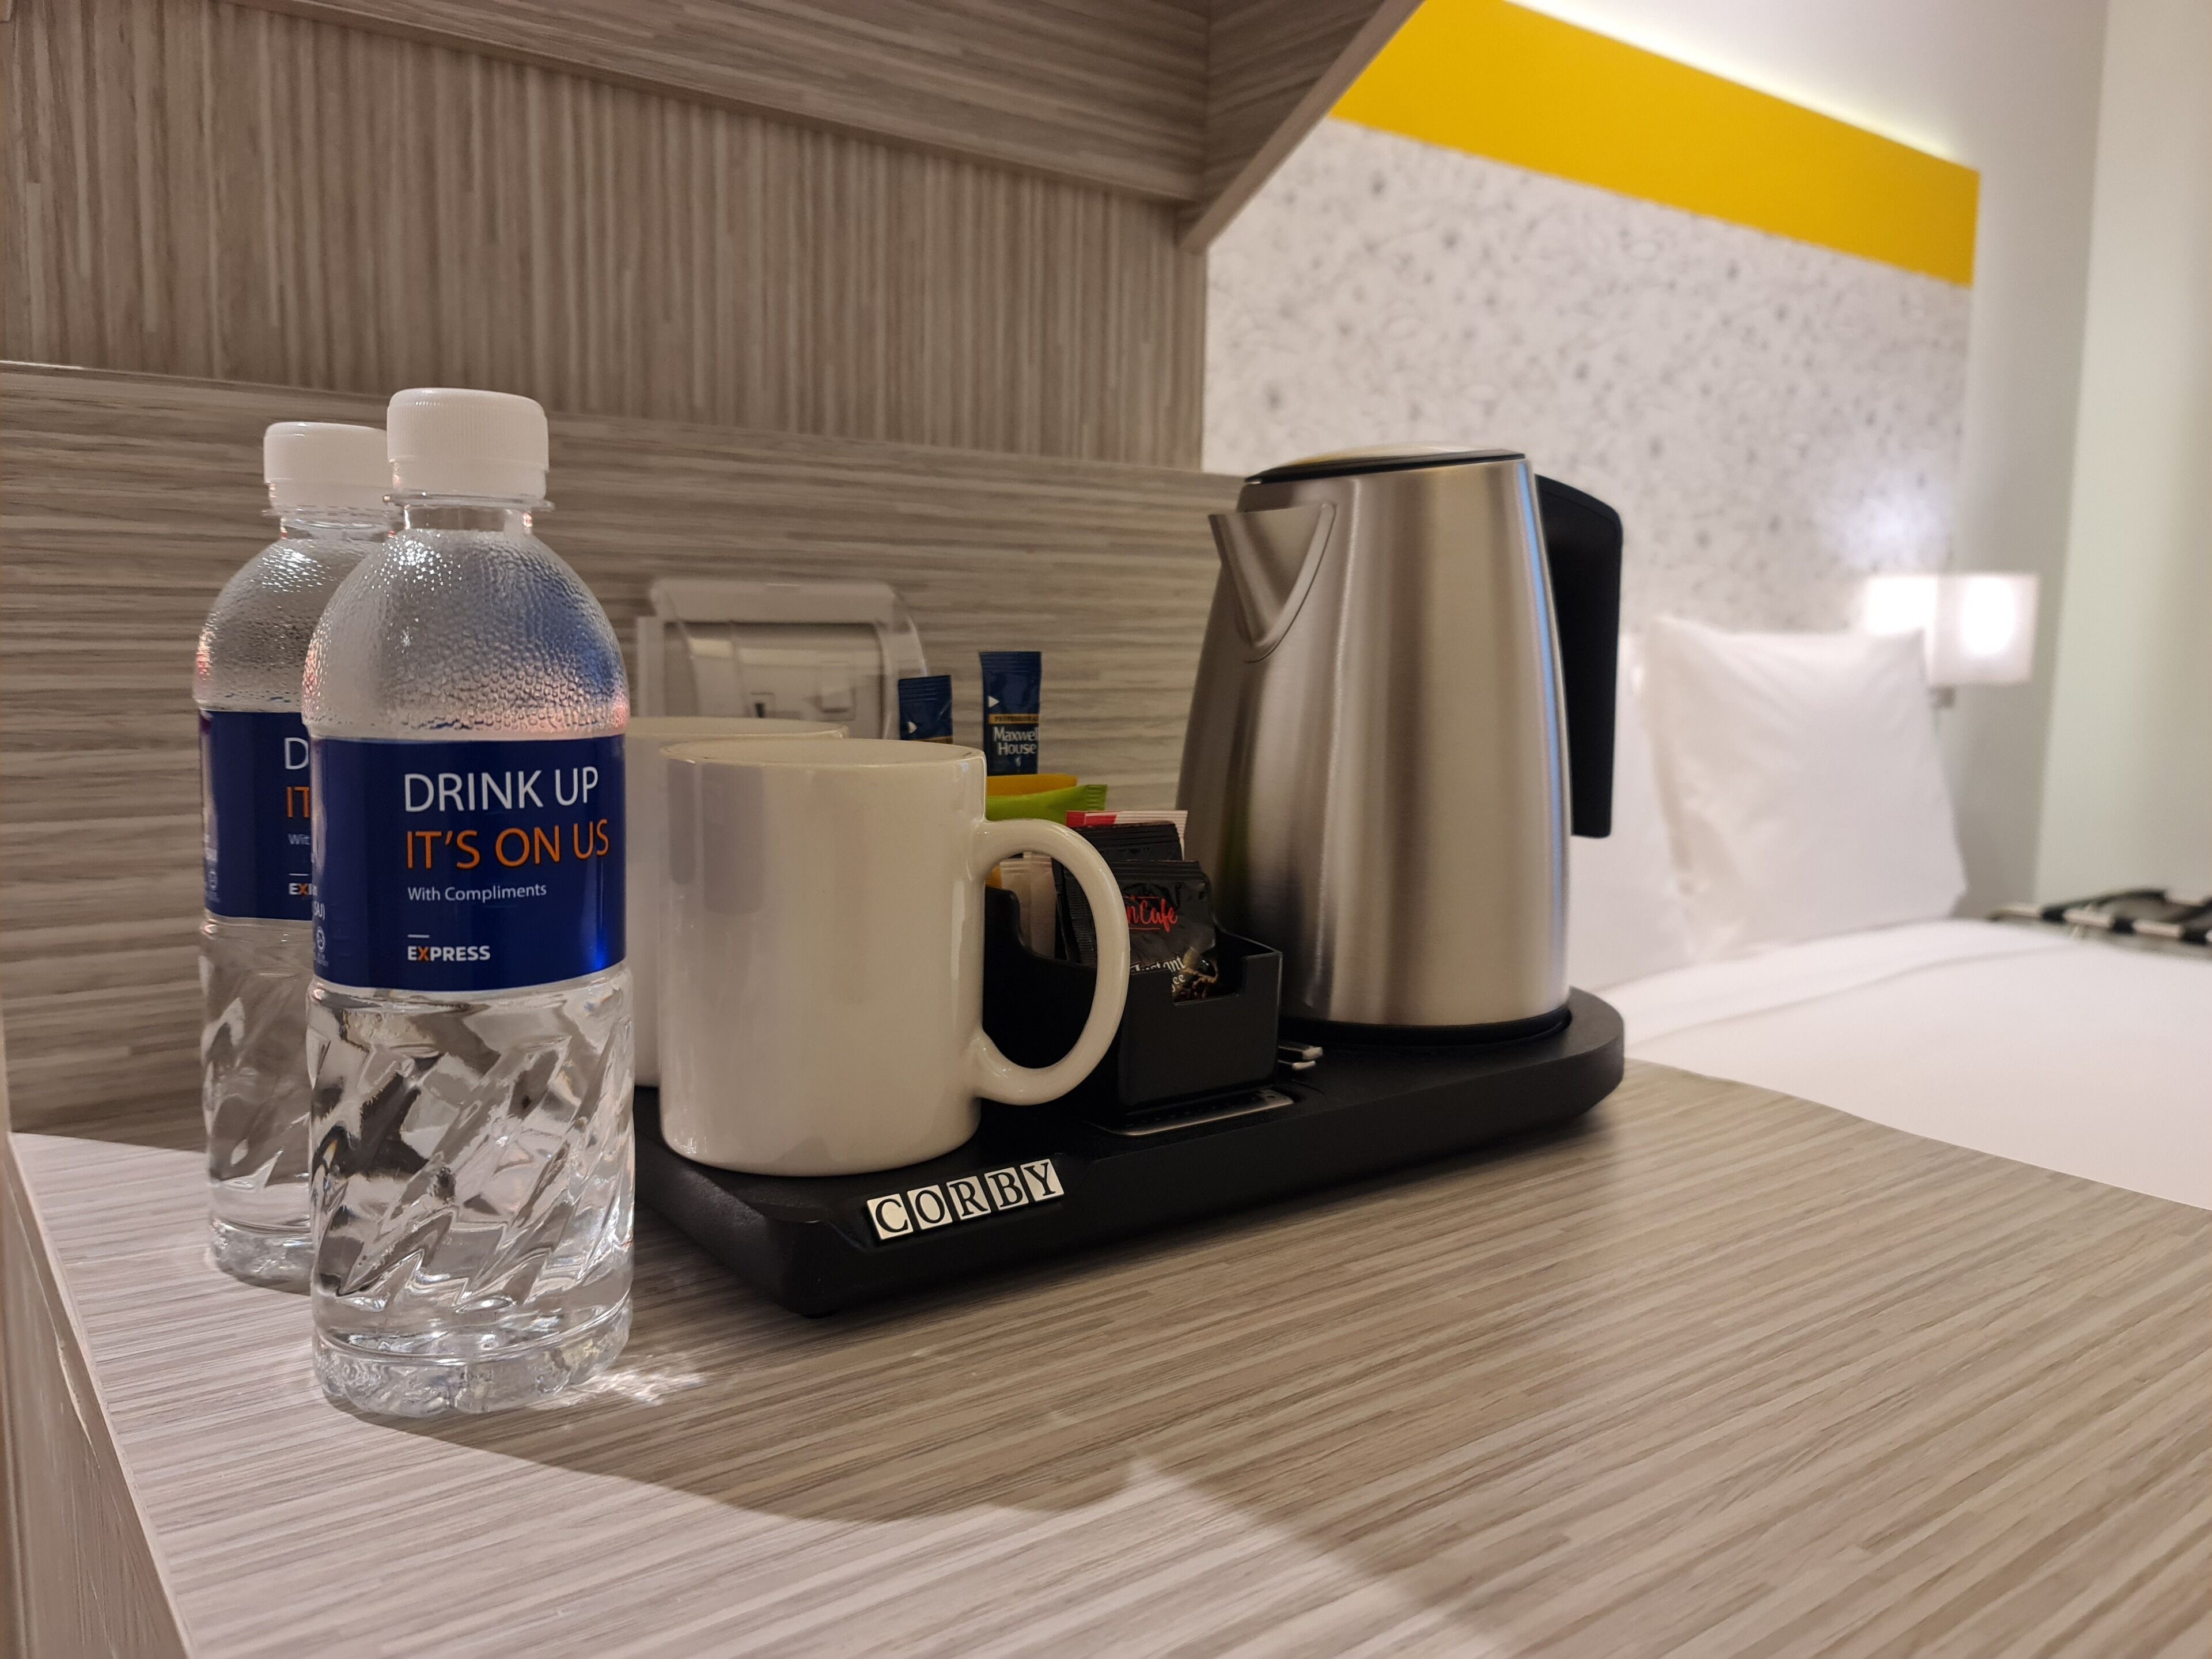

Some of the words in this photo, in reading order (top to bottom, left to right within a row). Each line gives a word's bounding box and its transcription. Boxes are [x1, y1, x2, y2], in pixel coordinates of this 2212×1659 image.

[998, 742, 1036, 755] House
[404, 770, 544, 812] DRINK
[555, 766, 599, 806] UP
[407, 830, 480, 870] IT'S
[495, 825, 560, 866] ON
[573, 819, 609, 859] US
[407, 886, 441, 902] With
[444, 883, 547, 904] Compliments
[407, 945, 491, 961] EXPRESS
[874, 1161, 1056, 1233] CORBY
